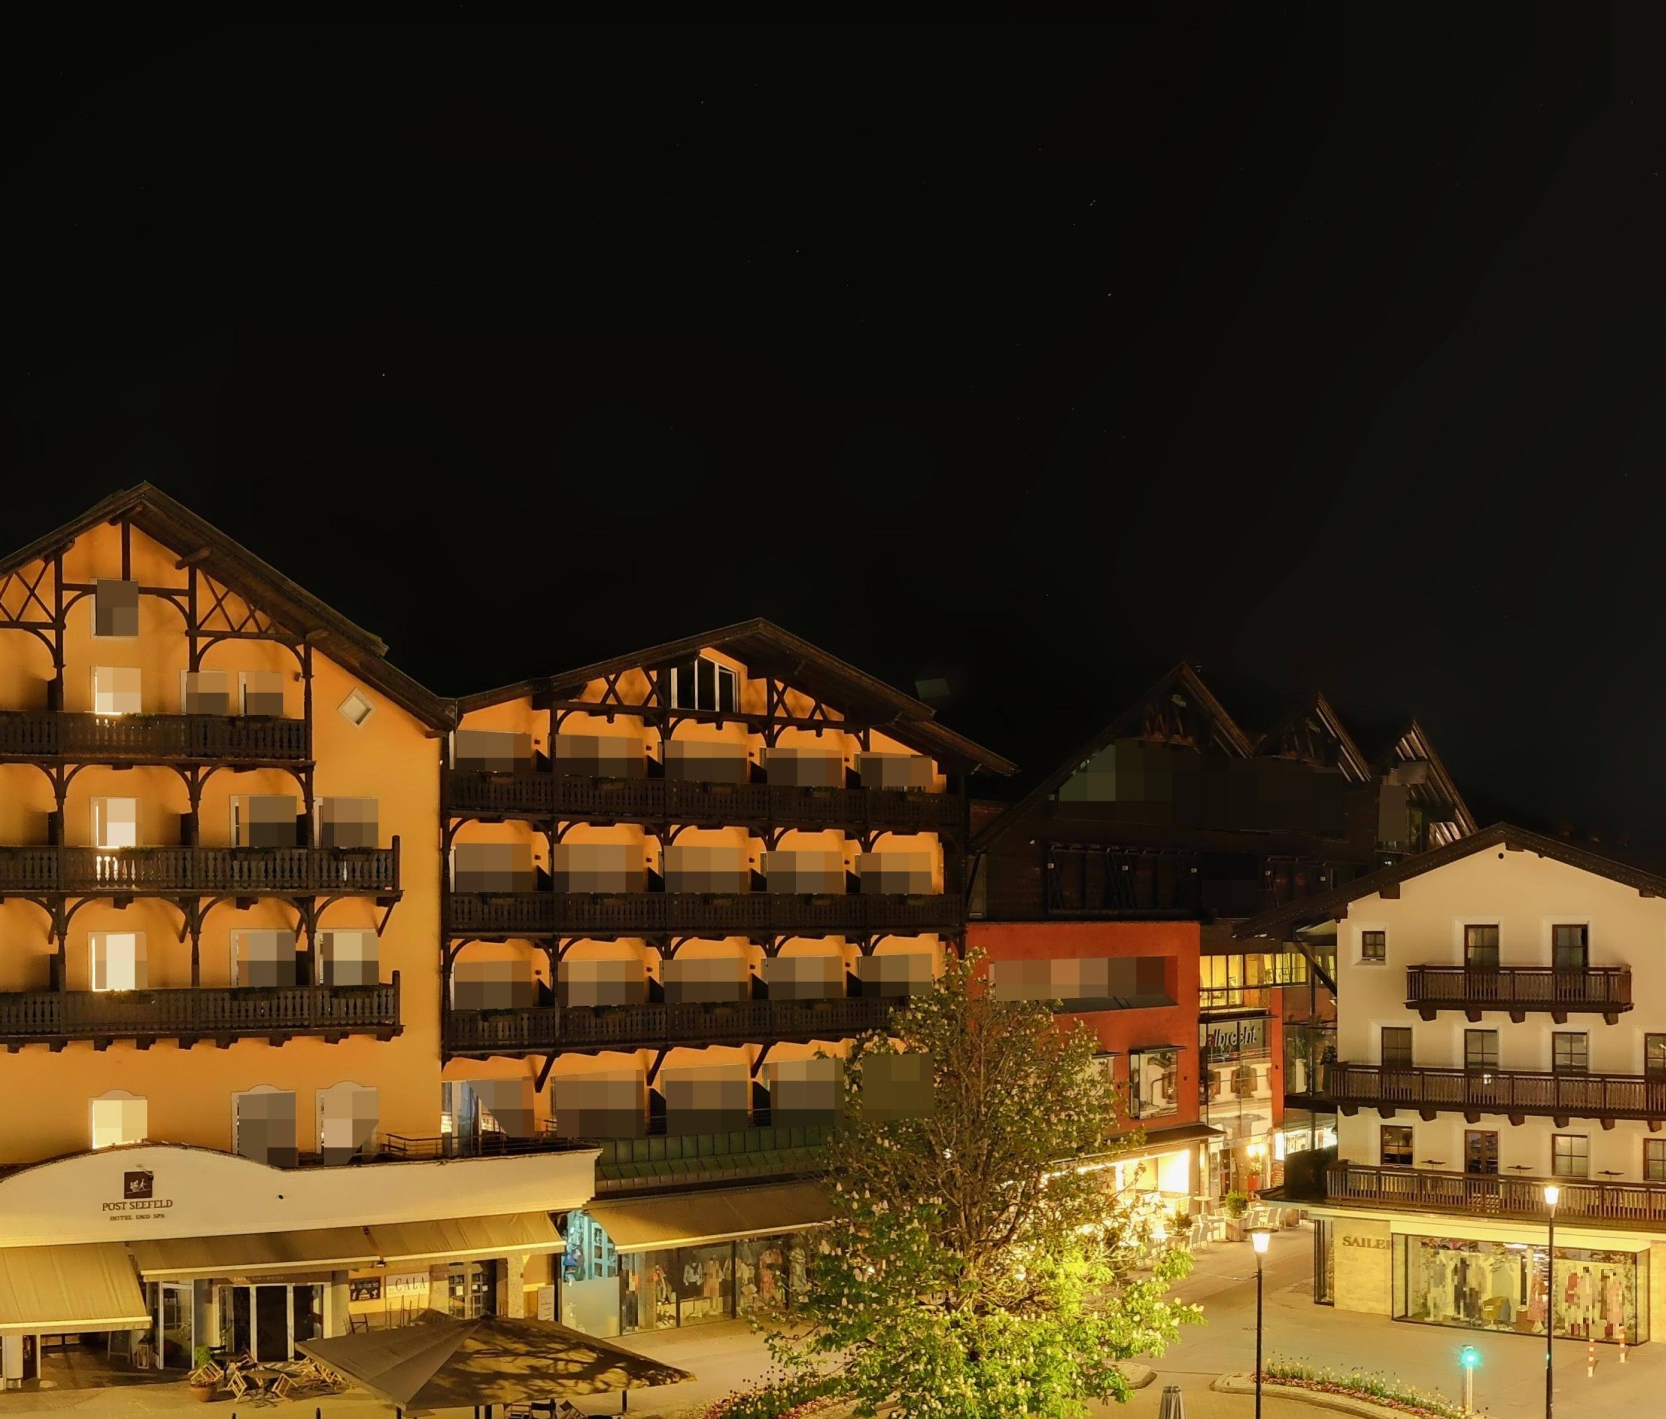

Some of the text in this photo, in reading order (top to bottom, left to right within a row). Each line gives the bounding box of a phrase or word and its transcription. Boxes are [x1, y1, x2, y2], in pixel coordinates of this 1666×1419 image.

[102, 1199, 173, 1211] POST SEEFELD
[395, 1276, 427, 1292] CALA
